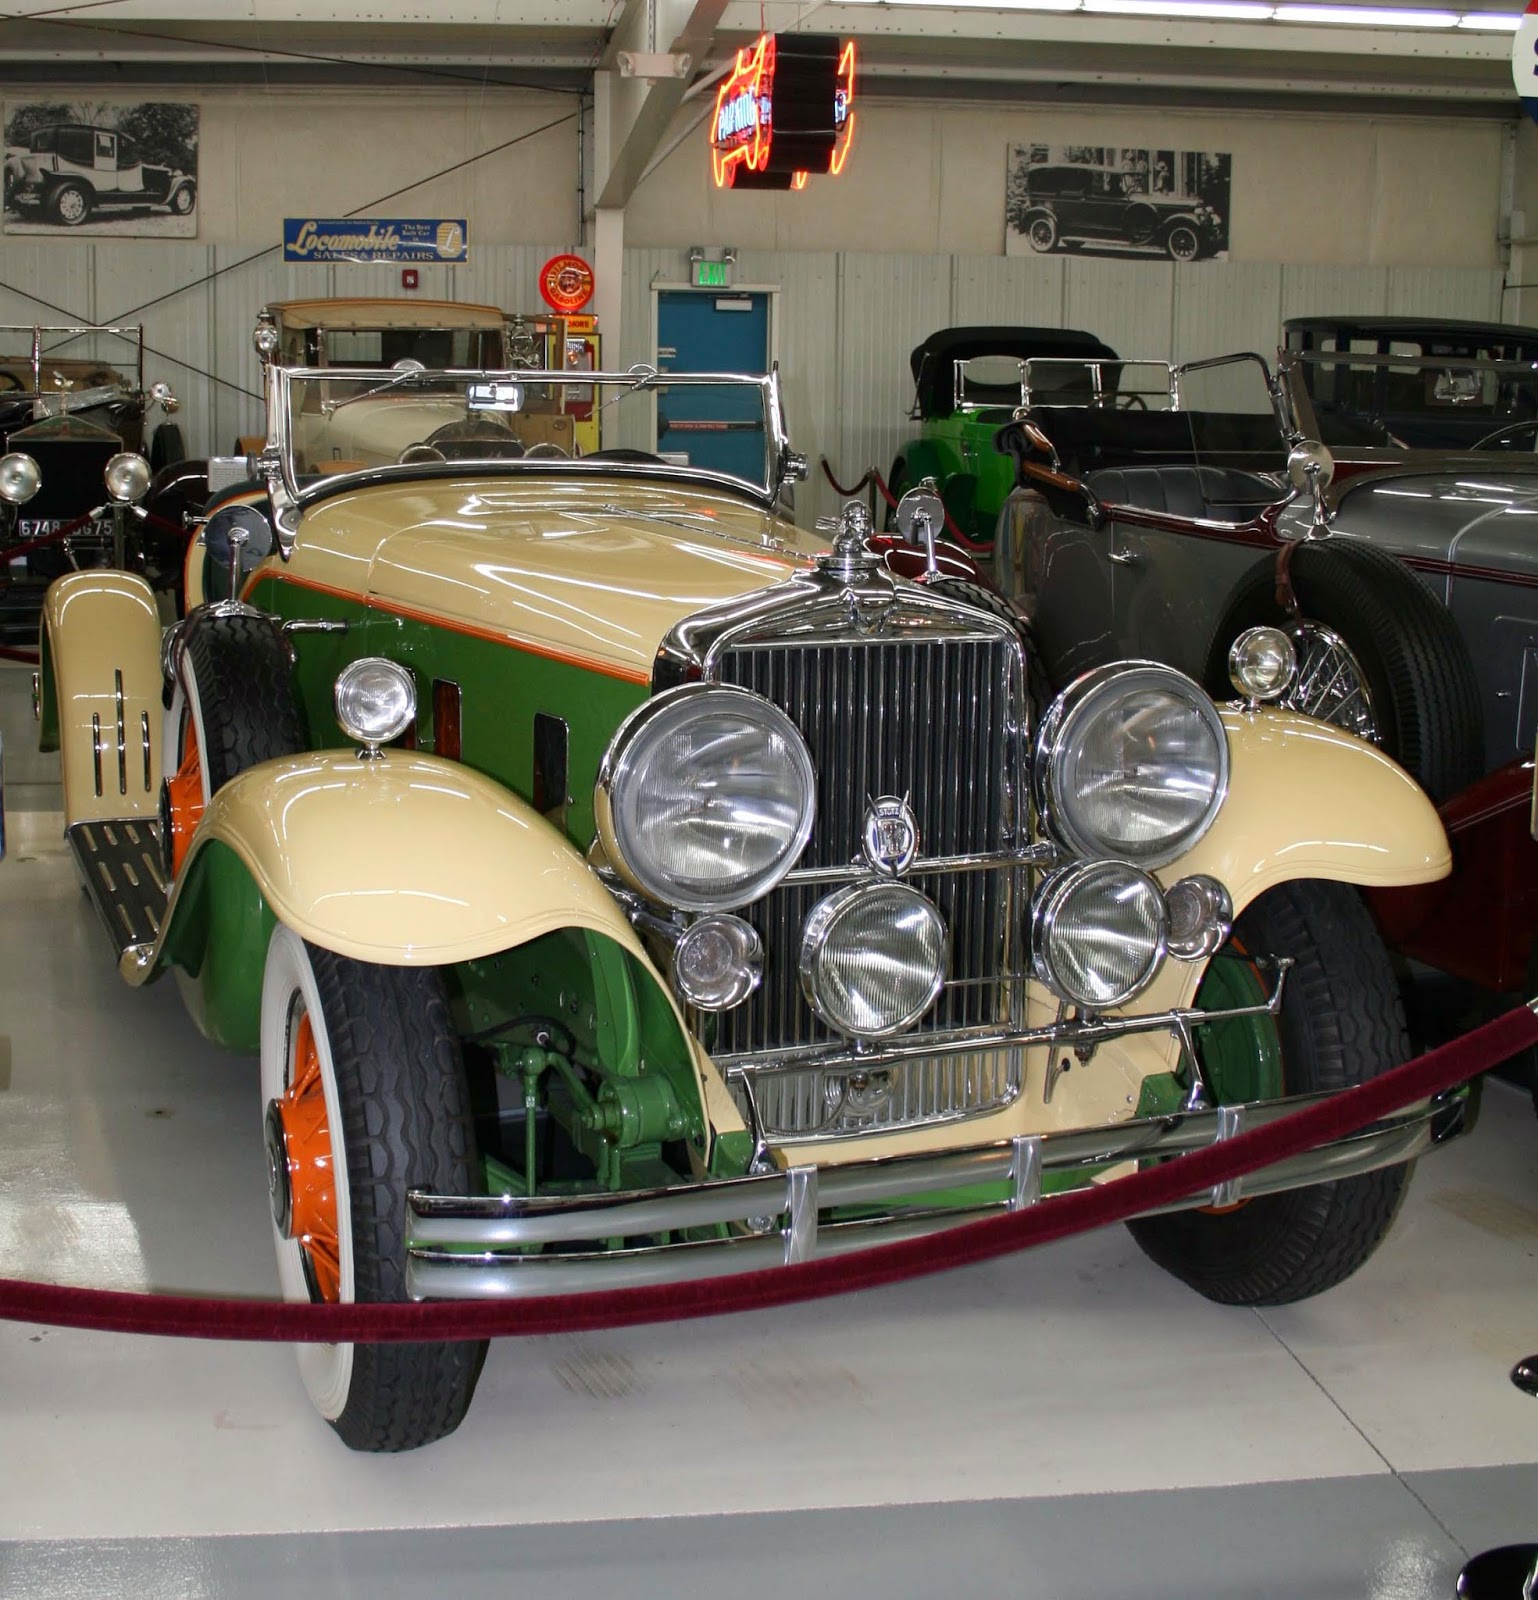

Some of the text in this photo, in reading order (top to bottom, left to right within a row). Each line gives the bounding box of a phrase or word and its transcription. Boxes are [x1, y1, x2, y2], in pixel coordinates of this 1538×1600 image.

[286, 221, 400, 256] Locomobile
[372, 251, 434, 261] REPAIRS
[699, 261, 726, 285] EXIT
[567, 320, 590, 329] MORE
[879, 807, 900, 817] STUTZ
